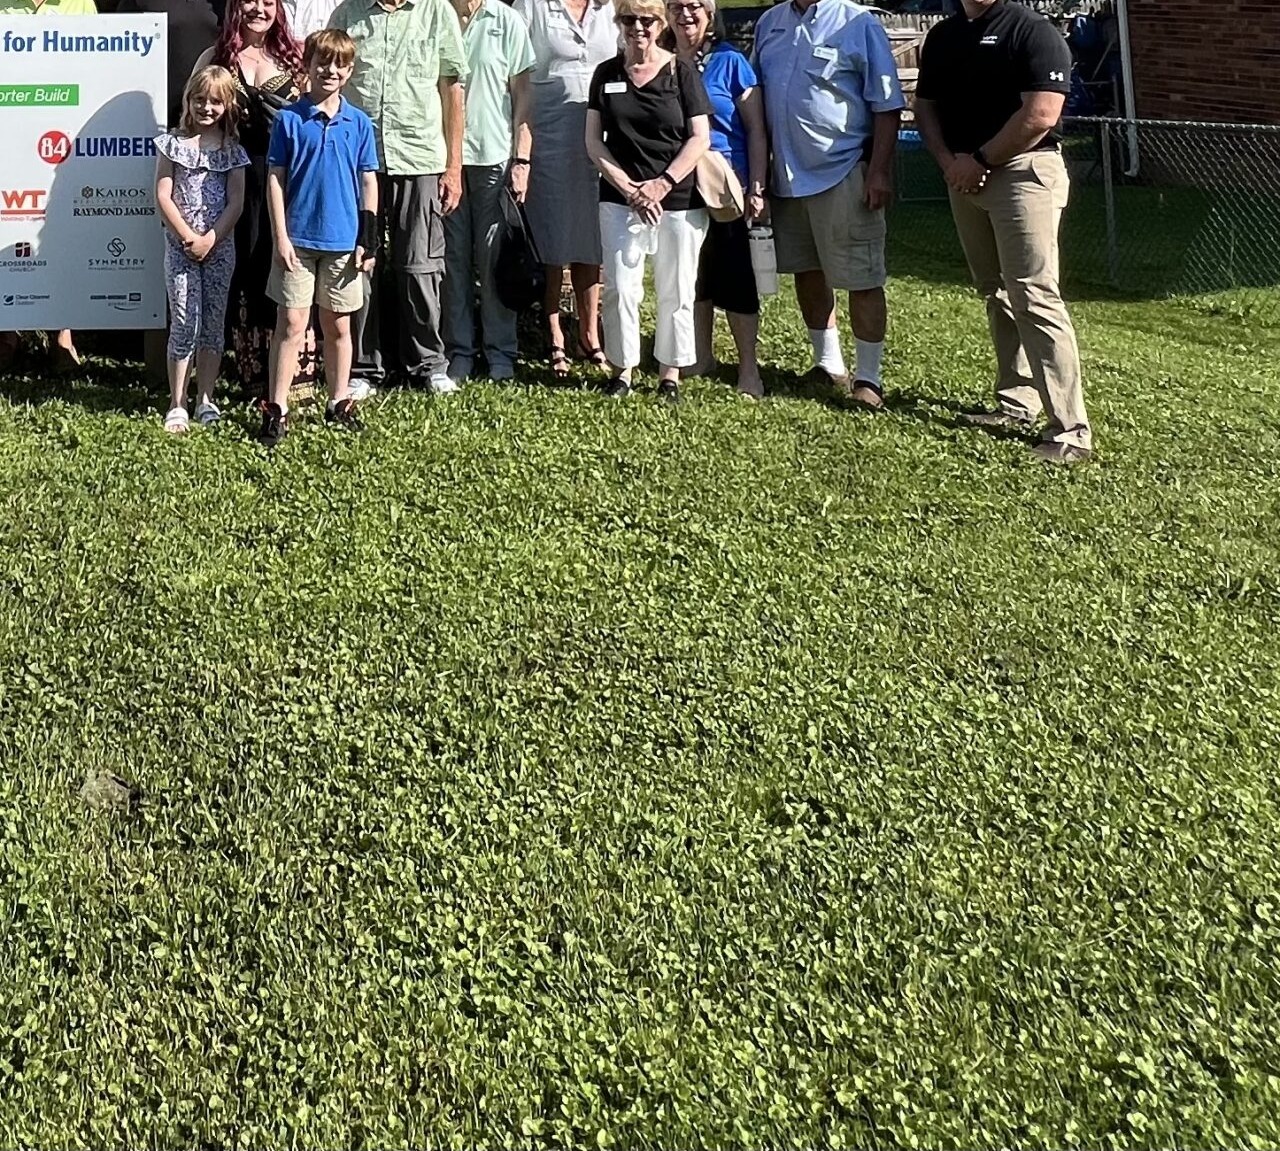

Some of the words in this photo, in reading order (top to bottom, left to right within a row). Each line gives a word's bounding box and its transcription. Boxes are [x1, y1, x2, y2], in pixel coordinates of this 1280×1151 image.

[4, 30, 36, 52] for
[34, 87, 70, 102] Build
[41, 137, 67, 158] 84
[75, 137, 157, 157] LUMBER
[1, 190, 46, 209] WT
[95, 188, 146, 198] KAIROS
[73, 207, 123, 216] RAYMOND
[124, 207, 156, 216] JAMES
